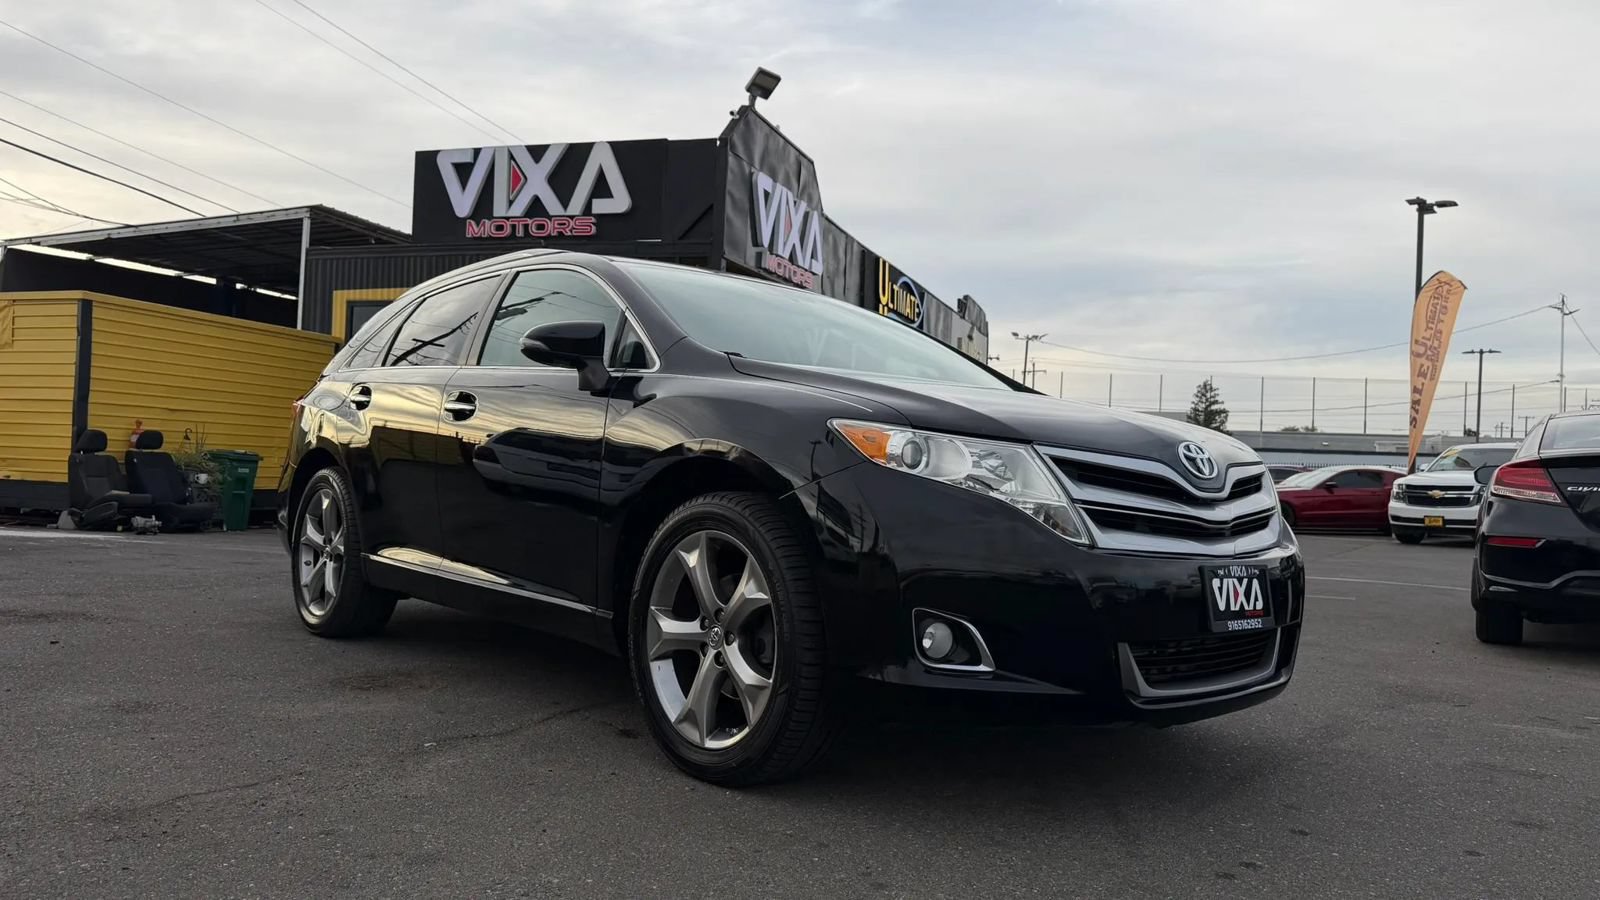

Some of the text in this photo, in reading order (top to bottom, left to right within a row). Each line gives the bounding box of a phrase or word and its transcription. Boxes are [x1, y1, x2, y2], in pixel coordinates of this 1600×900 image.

[437, 141, 632, 218] VIXA
[466, 216, 597, 238] MOTORS
[752, 171, 823, 276] VIXA
[767, 254, 814, 289] MOTORS
[1410, 363, 1430, 429] SALE
[1230, 565, 1247, 577] VIXA
[1212, 578, 1264, 612] VIXA
[1228, 619, 1263, 631] 9165162952
